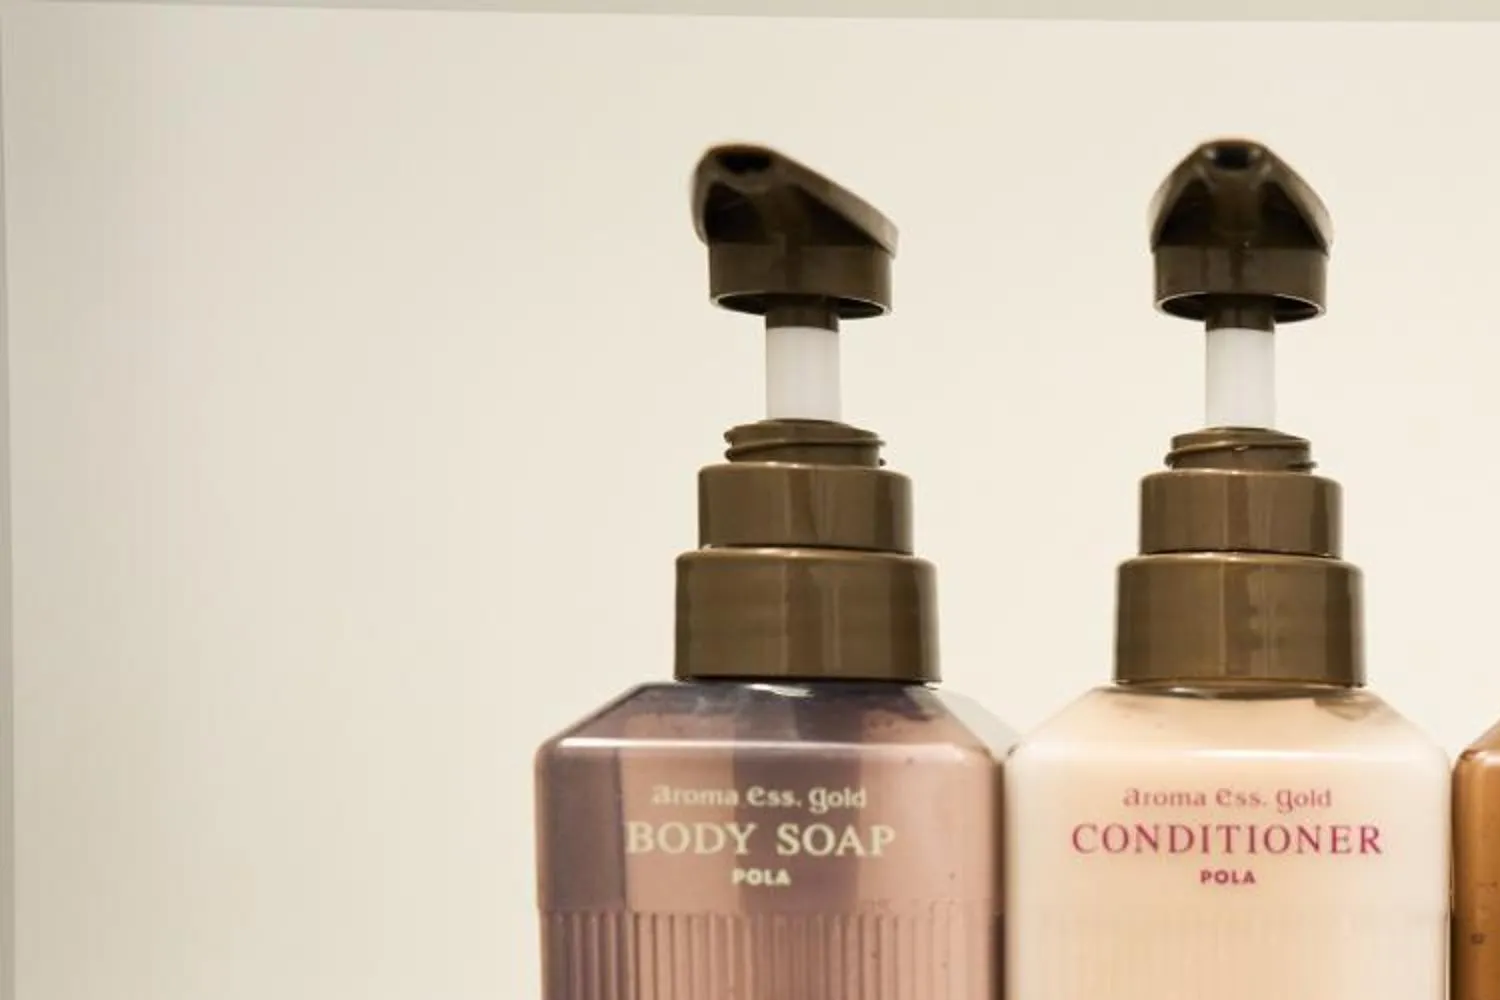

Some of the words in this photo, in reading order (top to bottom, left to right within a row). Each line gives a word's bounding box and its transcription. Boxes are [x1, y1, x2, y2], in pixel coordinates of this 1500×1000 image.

[651, 784, 738, 807] aroma
[746, 785, 802, 808] ess.
[808, 786, 867, 813] gold
[1123, 787, 1206, 808] aroma
[1215, 788, 1267, 808] ess.
[1276, 788, 1332, 814] gold
[625, 820, 757, 855] BODY
[776, 823, 896, 857] SOAP
[1071, 823, 1384, 855] CONDITIONER
[732, 868, 791, 885] POLA
[1200, 869, 1256, 885] POLA
